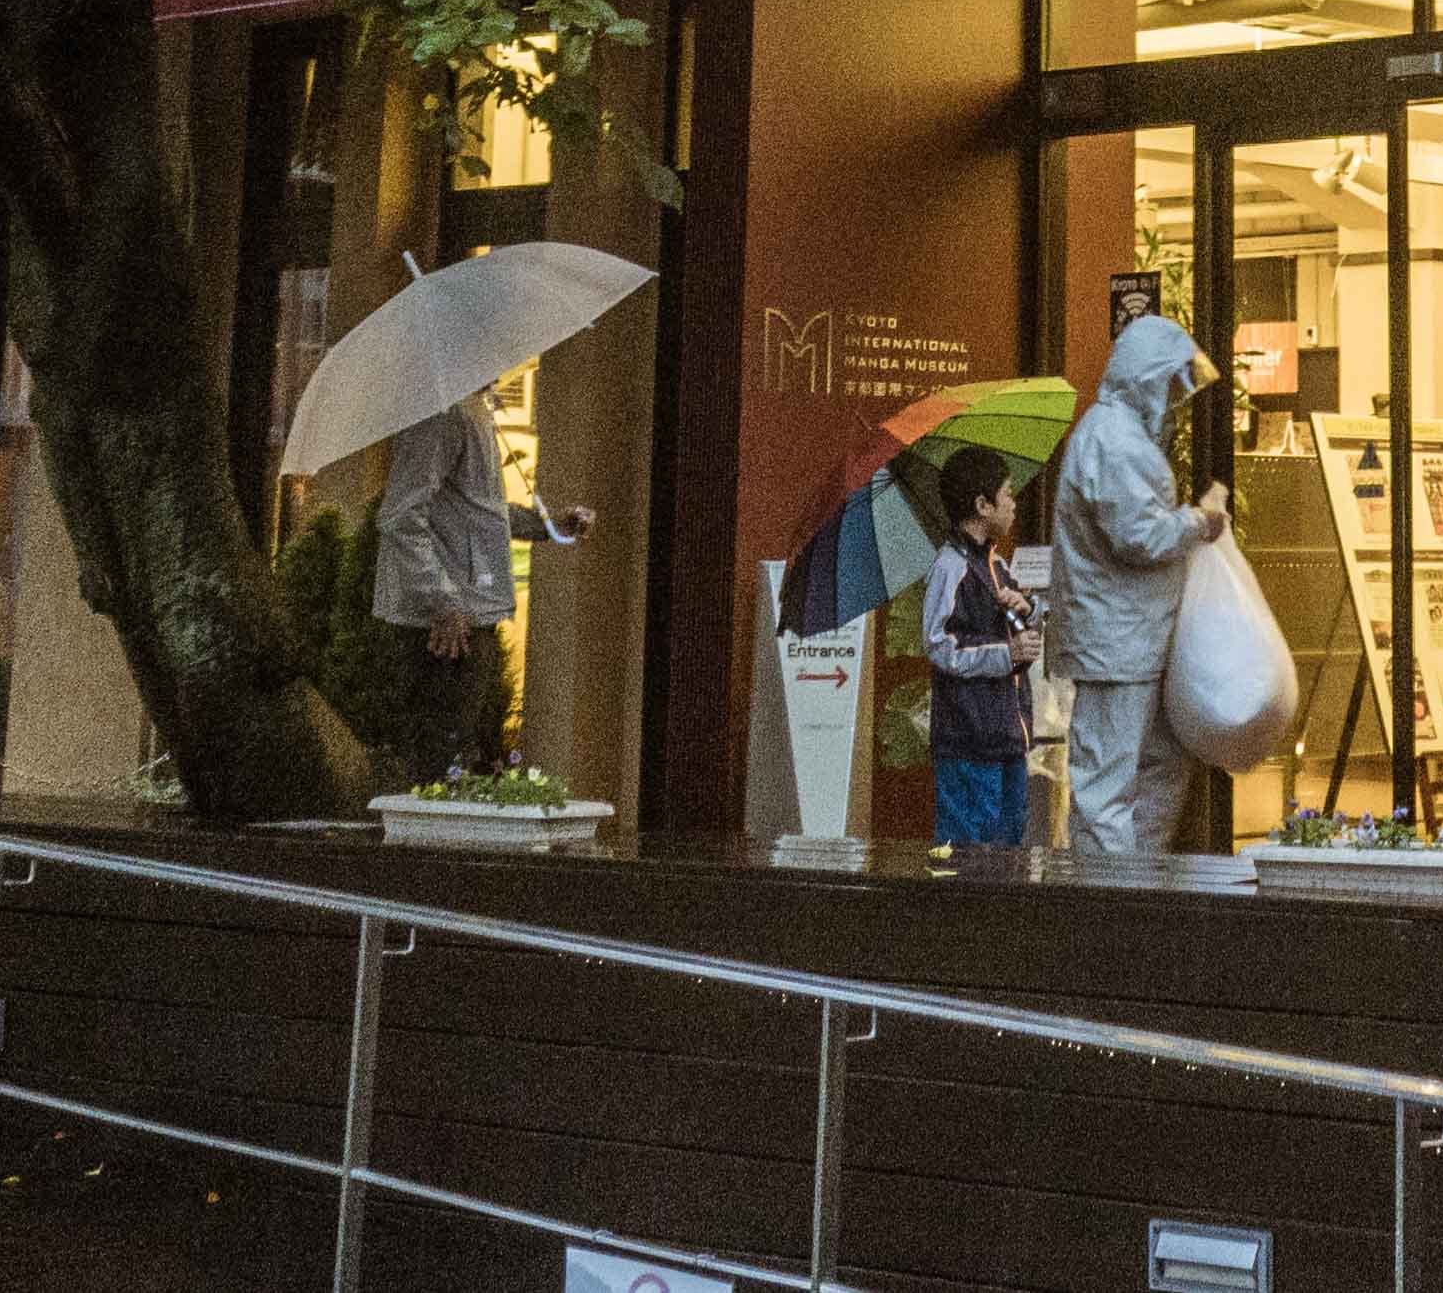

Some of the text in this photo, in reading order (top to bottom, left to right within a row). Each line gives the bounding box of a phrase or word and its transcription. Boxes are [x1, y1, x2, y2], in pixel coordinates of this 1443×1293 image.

[845, 335, 969, 353] INTERNATIONAL
[845, 356, 970, 373] MANGA MUSEUM
[787, 642, 856, 658] Entrance
